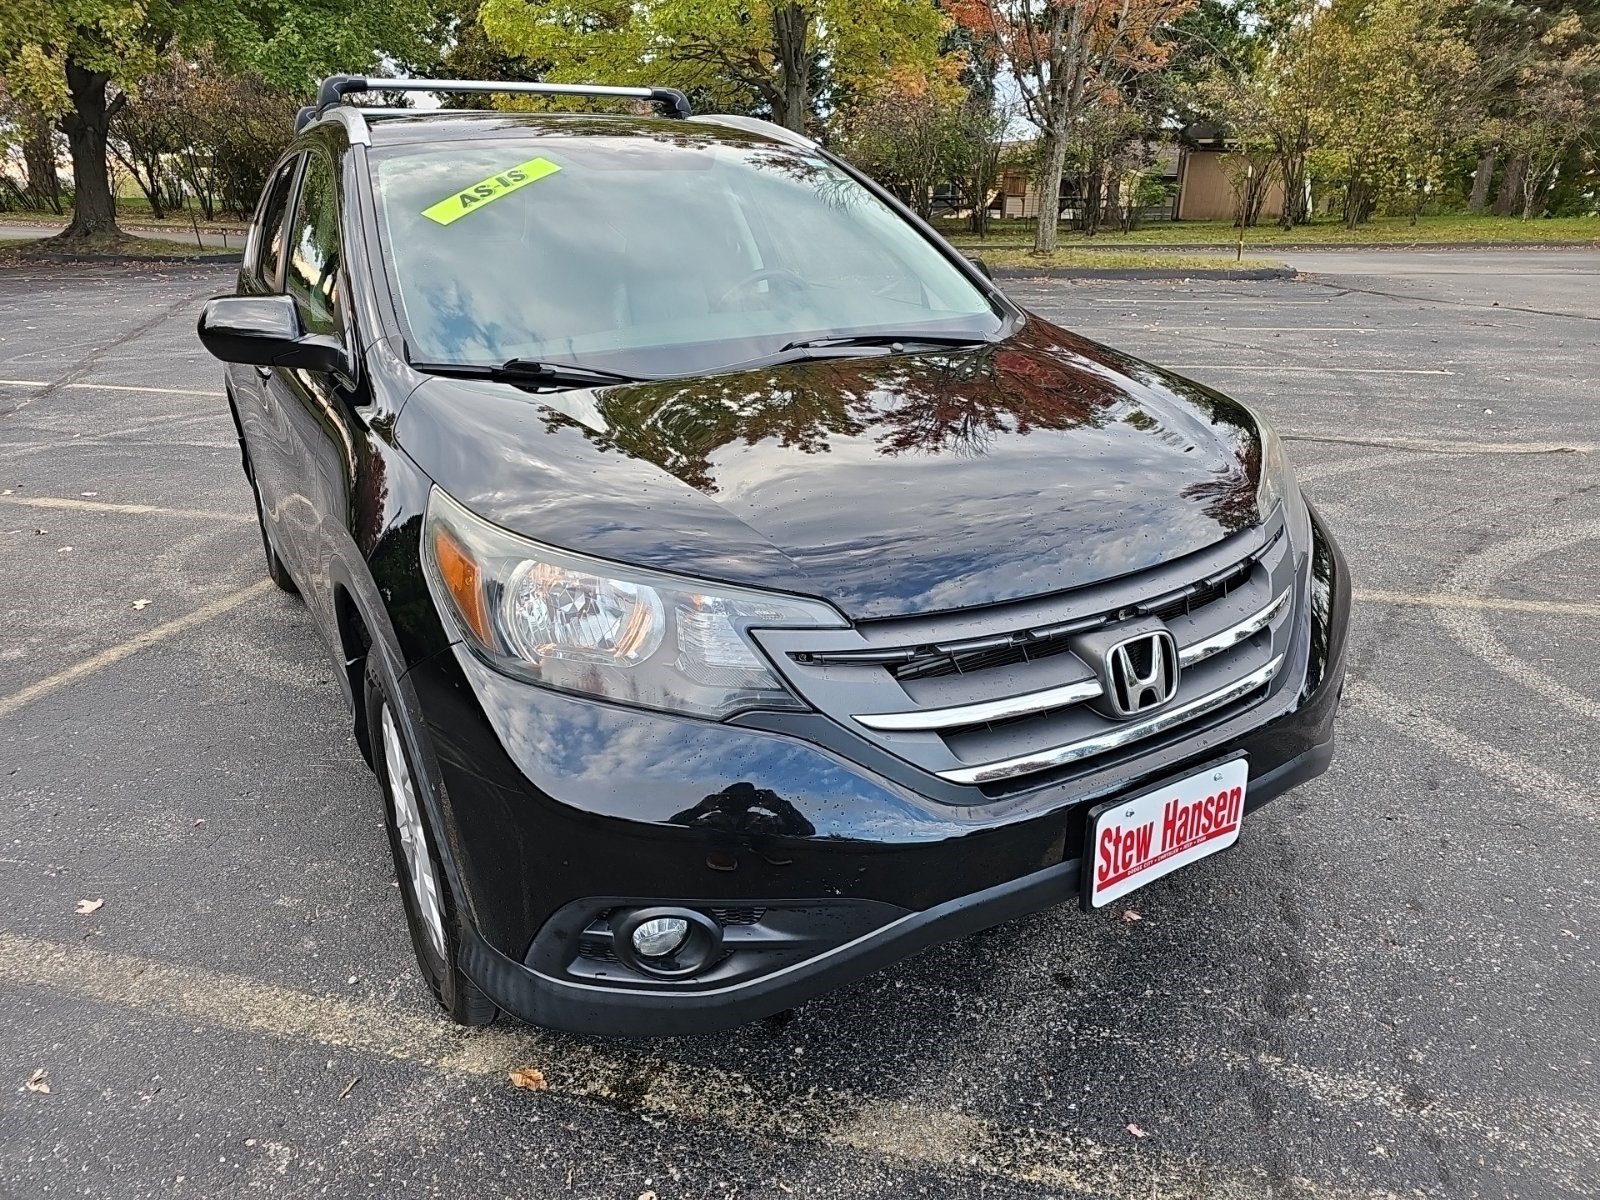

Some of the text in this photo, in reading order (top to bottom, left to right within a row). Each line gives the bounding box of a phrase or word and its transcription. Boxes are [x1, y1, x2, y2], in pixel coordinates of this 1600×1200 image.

[459, 170, 527, 208] AS-IS
[1098, 787, 1242, 882] Stew Hansen
[1127, 835, 1207, 876] DODGE CITY CHRYSLER JEEP RAM
